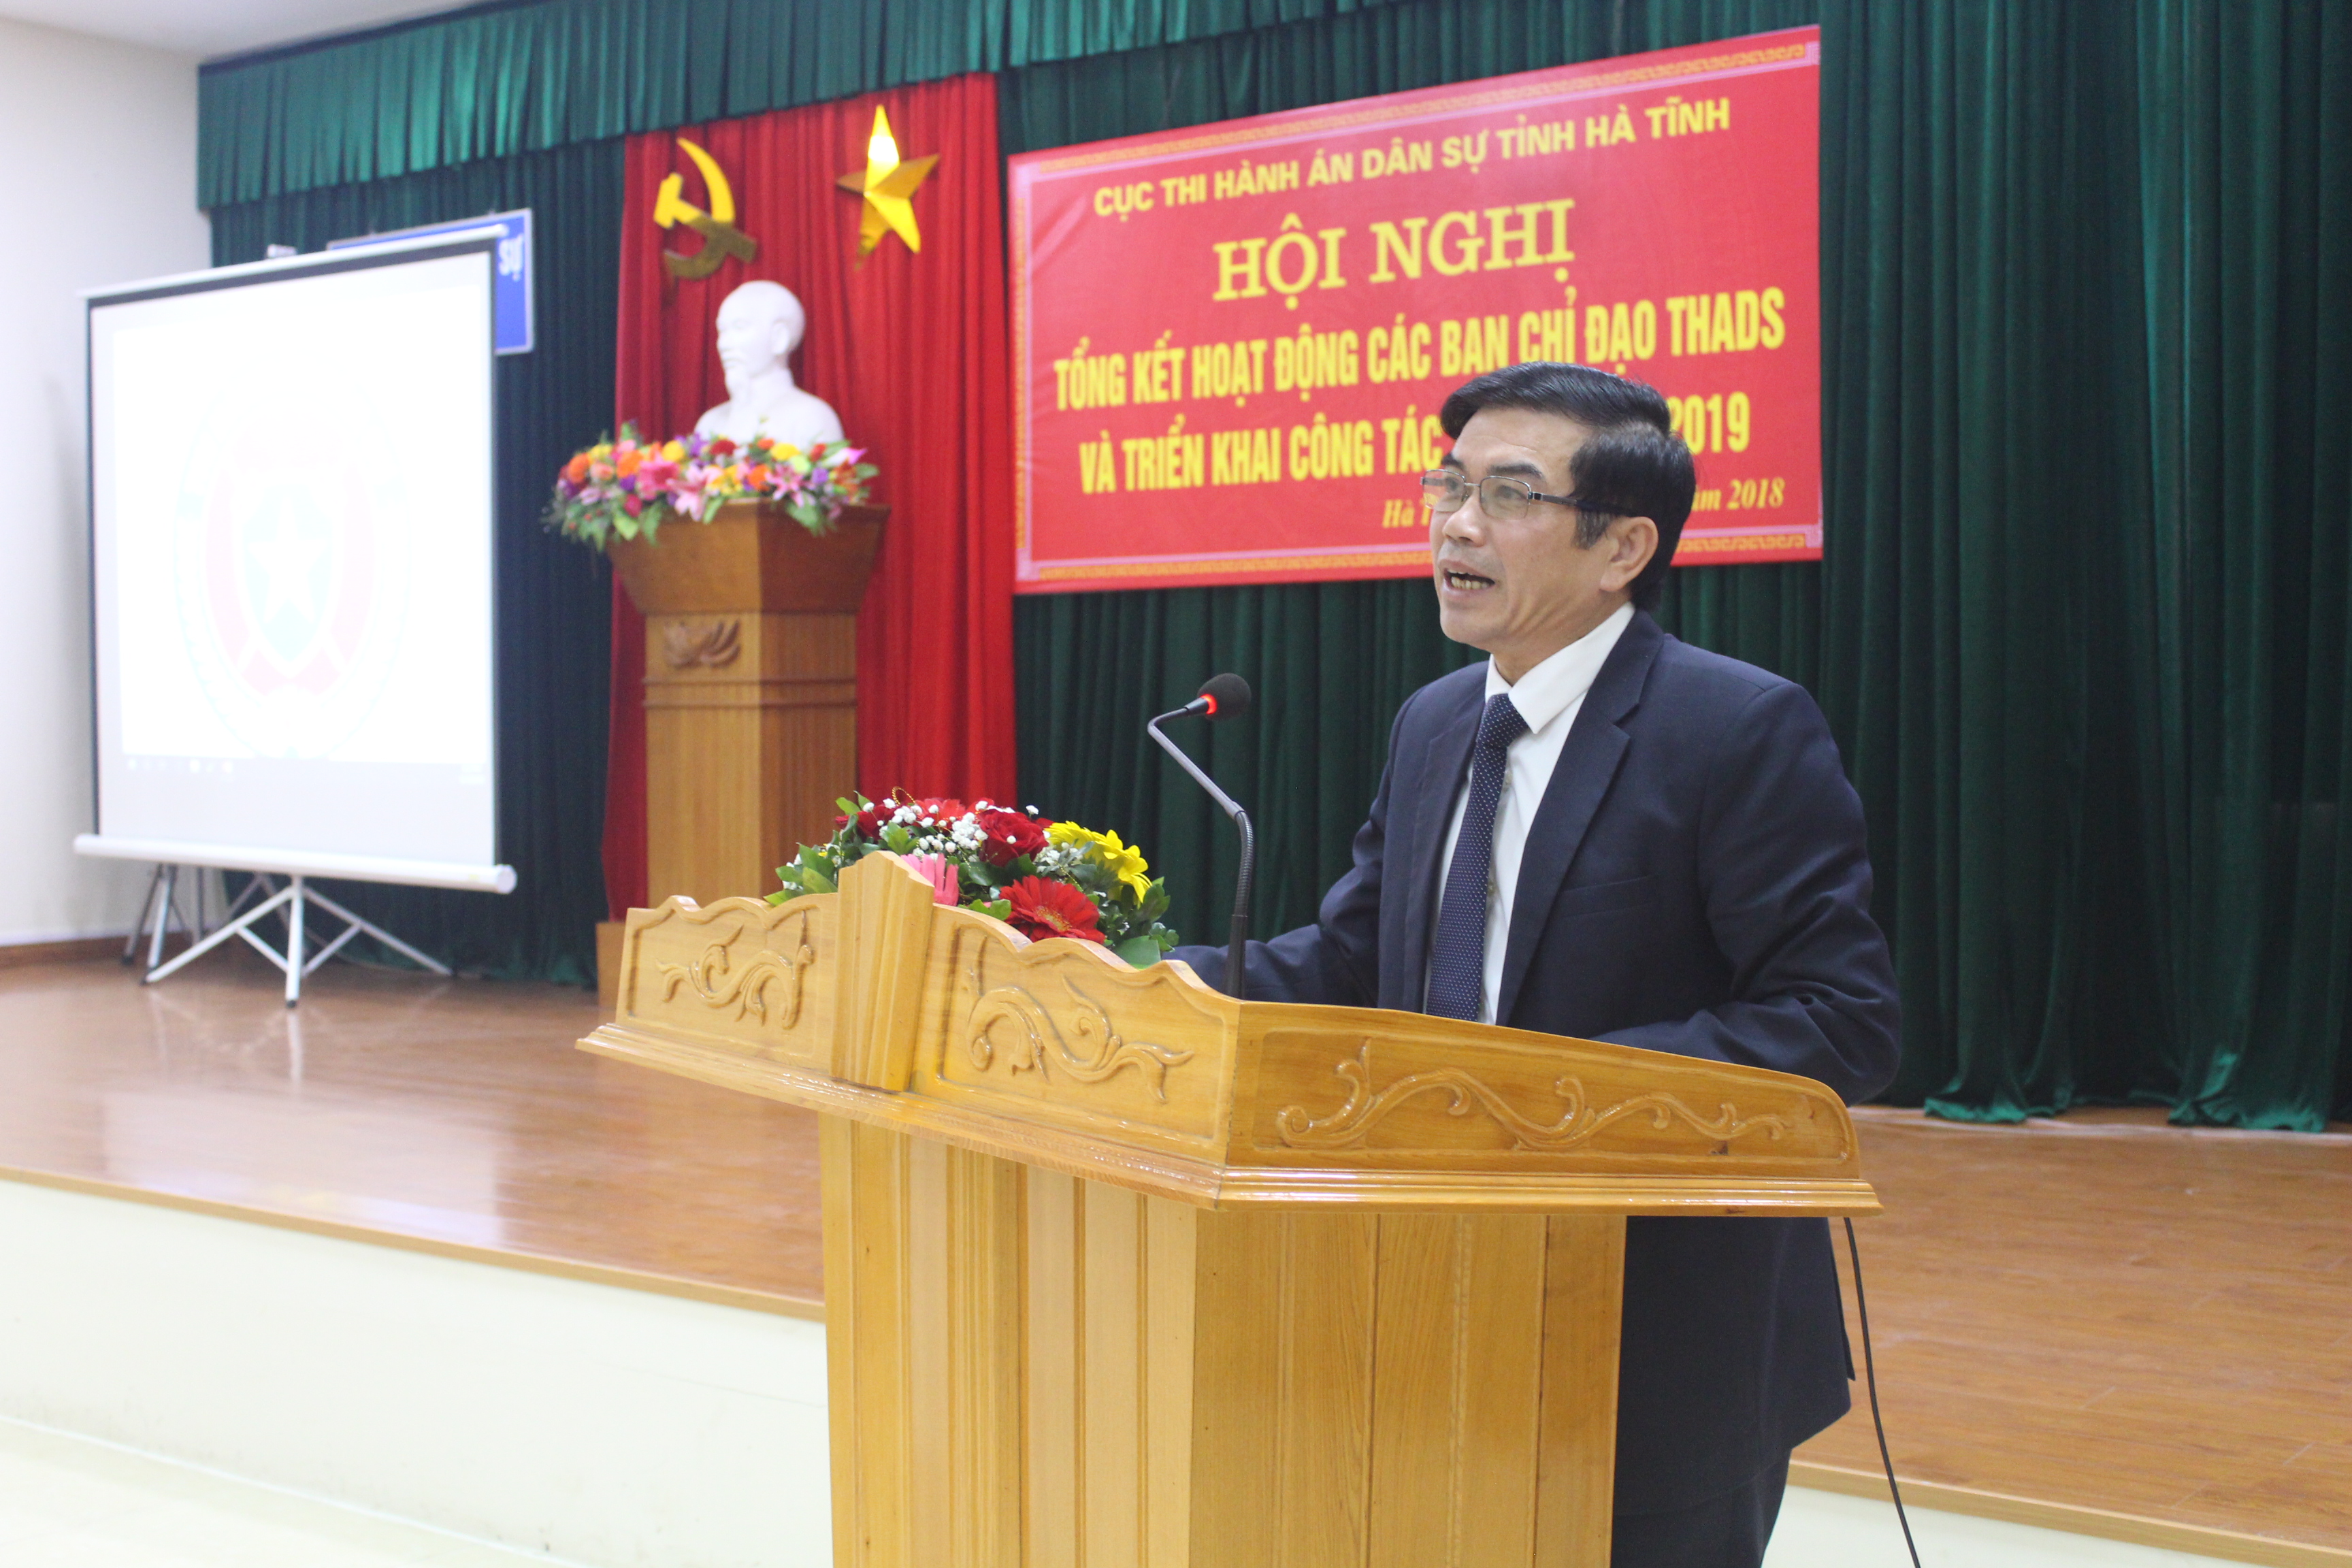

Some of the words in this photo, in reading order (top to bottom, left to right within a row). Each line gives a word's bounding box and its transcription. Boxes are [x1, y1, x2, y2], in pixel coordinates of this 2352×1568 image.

[1094, 182, 1154, 222] CỤC
[1160, 174, 1207, 207] THI
[1214, 160, 1299, 199] HÀNH
[1307, 148, 1353, 186] ÁN
[1362, 137, 1432, 179] DÂN
[1442, 129, 1489, 173] SỰ
[1497, 114, 1575, 159] TỈNH
[1586, 103, 1636, 148] HÀ
[1644, 96, 1730, 139] TĨNH
[1213, 213, 1347, 310] HỘI
[1369, 199, 1575, 282] NGHỊ
[1054, 336, 1126, 410] TỔNG
[1132, 329, 1186, 404] KẾT
[1192, 340, 1267, 407] HOẠT
[1273, 323, 1359, 402] ĐỘNG
[1367, 312, 1431, 383] CÁC
[1440, 314, 1509, 377] BAN
[1518, 285, 1576, 363] CHỈ
[1584, 299, 1656, 375] ĐẠO
[1666, 287, 1785, 357] THADS
[1079, 430, 1116, 493] VÀ
[1121, 413, 1205, 491] TRIỂN
[1211, 427, 1281, 485] KHAI
[1288, 412, 1374, 481] CÔNG
[1381, 404, 1442, 474] TÁC
[1382, 499, 1415, 528] Hà
[1727, 477, 1786, 510] 2018
